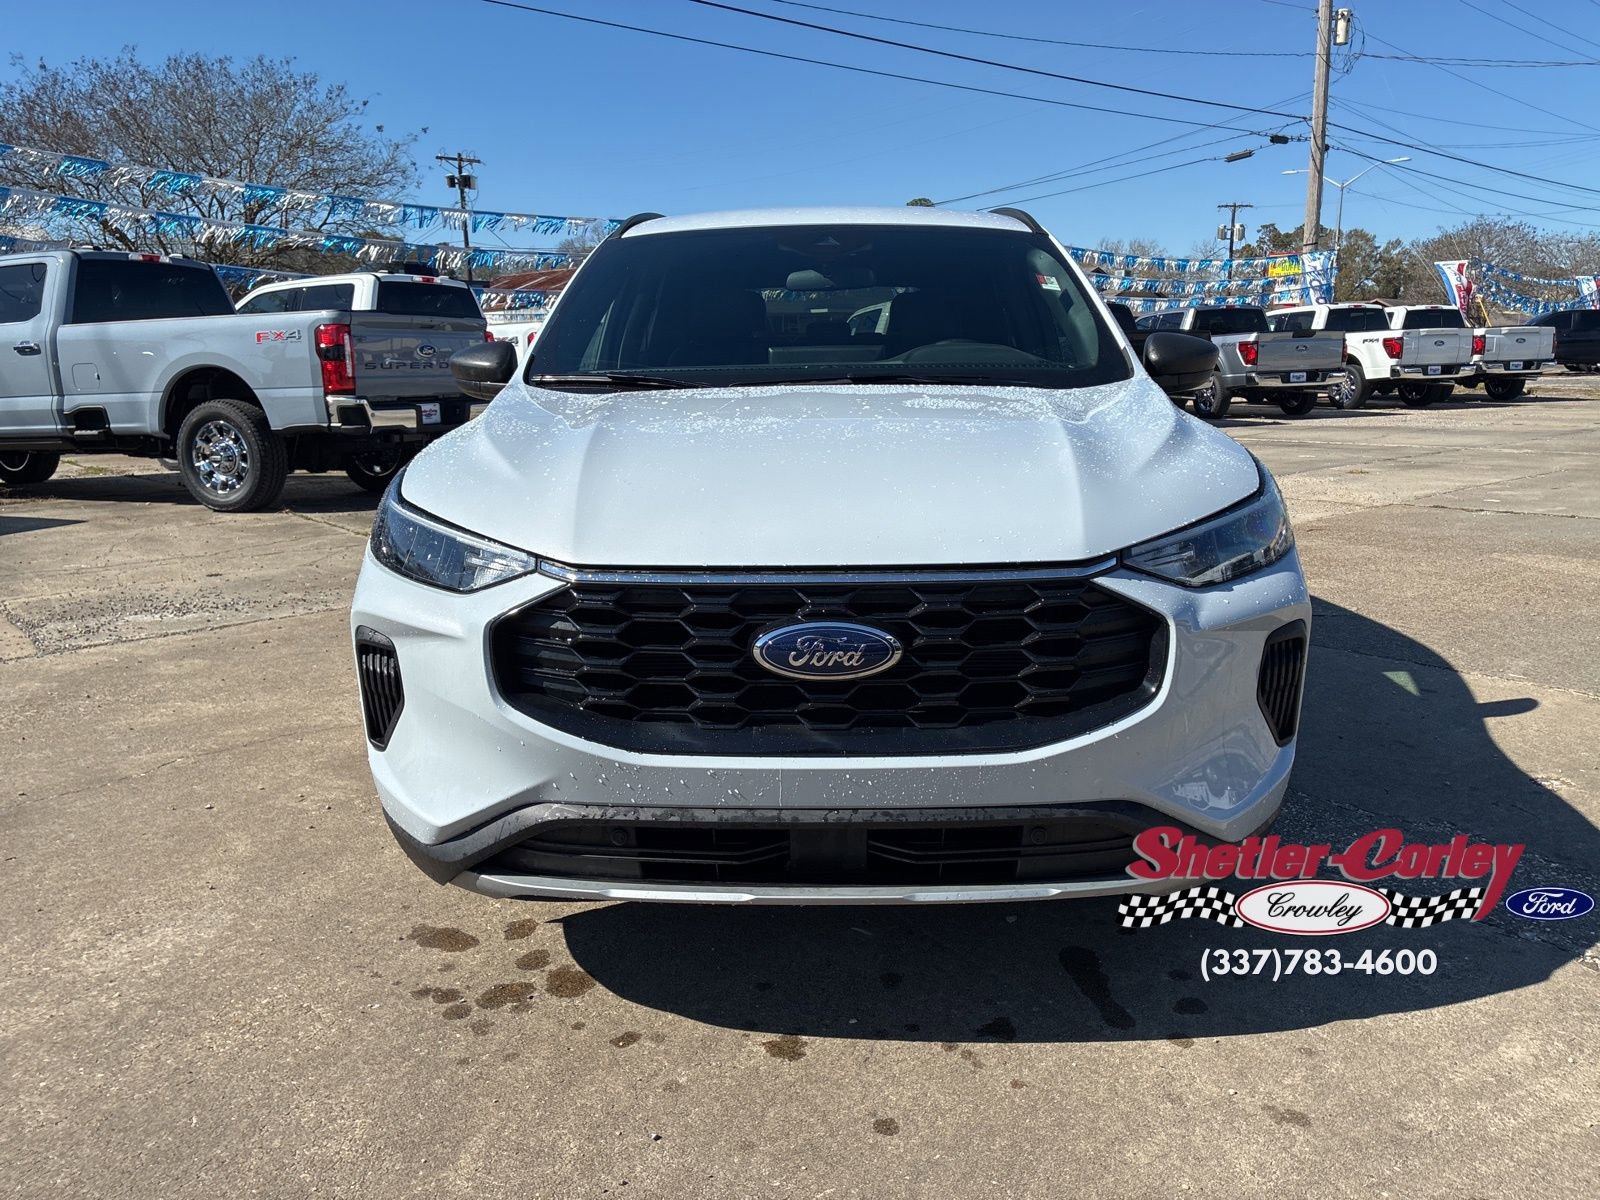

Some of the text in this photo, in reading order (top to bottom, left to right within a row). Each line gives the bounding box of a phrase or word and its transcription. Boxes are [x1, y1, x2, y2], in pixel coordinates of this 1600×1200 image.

[256, 330, 302, 344] FX4
[364, 362, 433, 370] SUPER
[788, 635, 866, 667] Ford
